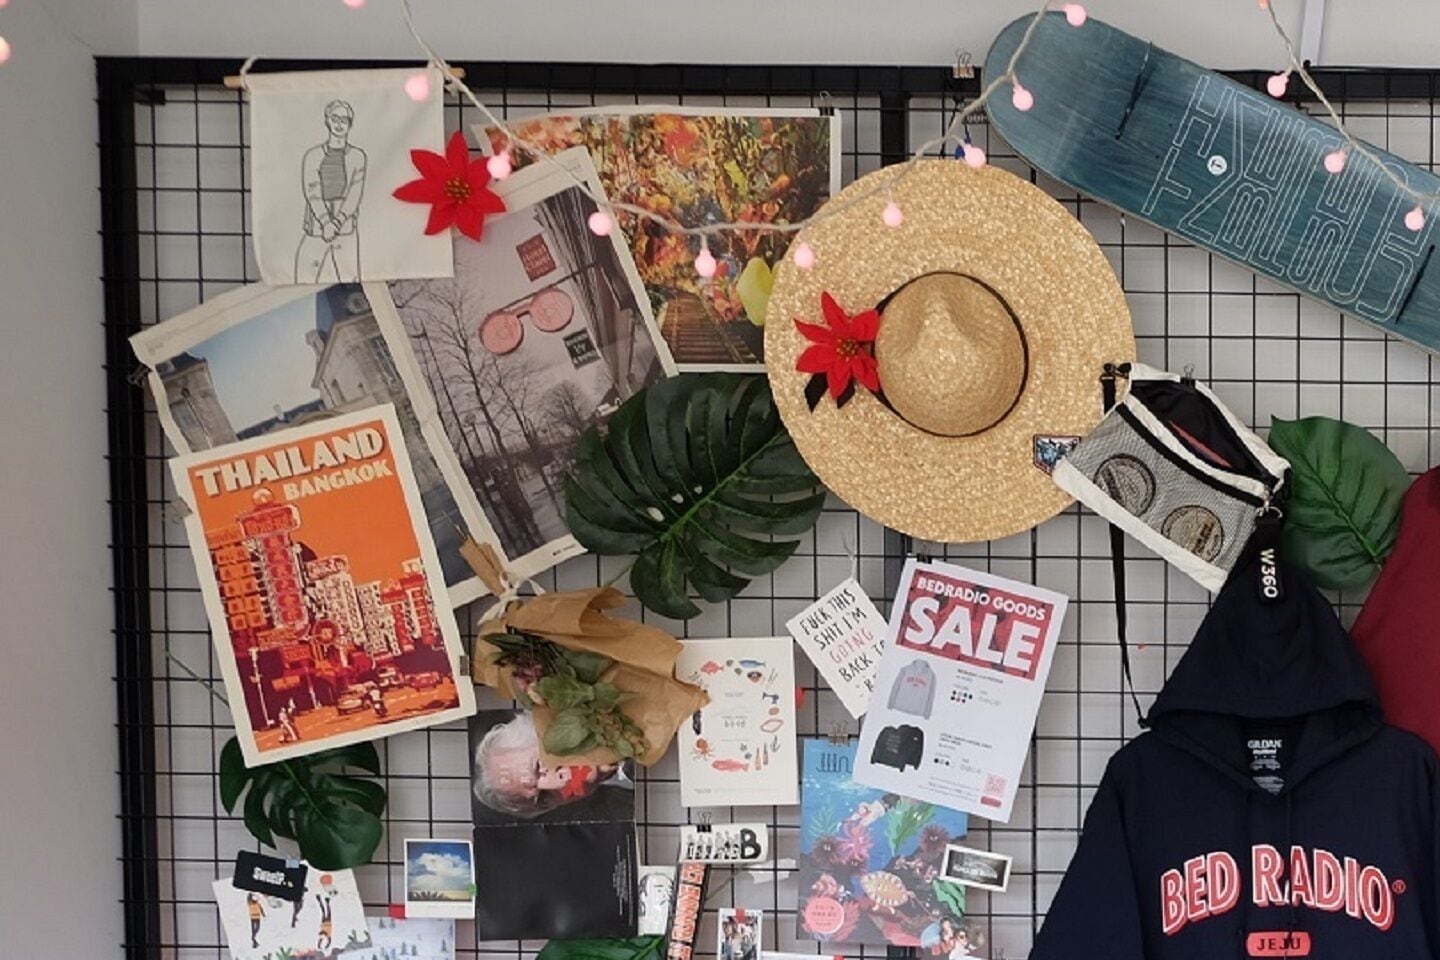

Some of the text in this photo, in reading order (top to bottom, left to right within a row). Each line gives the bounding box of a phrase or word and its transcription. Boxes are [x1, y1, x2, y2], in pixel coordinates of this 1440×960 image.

[195, 427, 384, 498] THAILAND
[283, 459, 393, 501] BANGKOK
[1260, 549, 1279, 598] W360
[799, 588, 856, 635] FUCK THIS
[917, 577, 1046, 622] BEDRADIO GOODS
[814, 622, 844, 651] SHIT
[829, 628, 874, 663] GOING
[903, 596, 1041, 673] SALE
[838, 652, 873, 682] BACK
[1160, 851, 1242, 936] BED
[1256, 938, 1301, 951] JEJU
